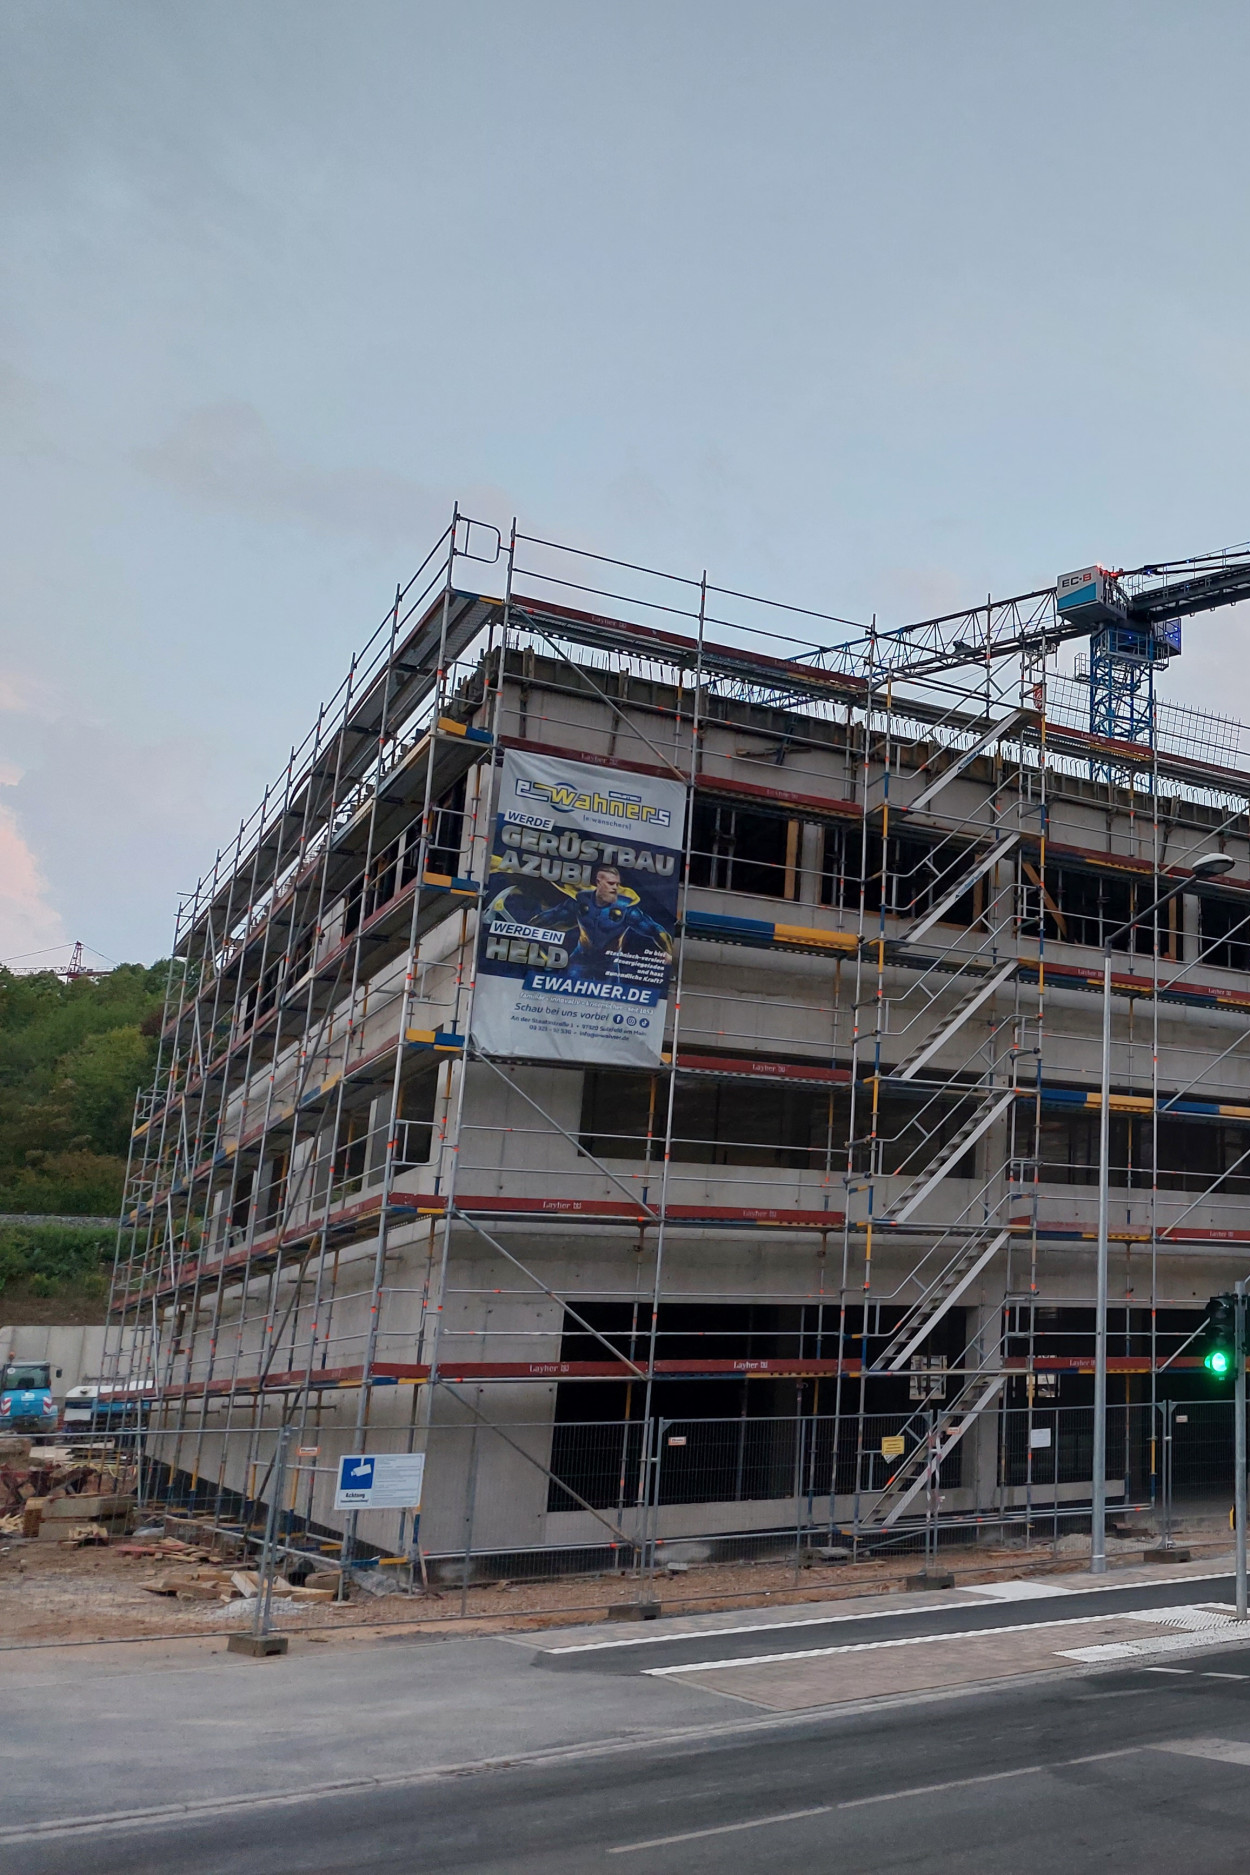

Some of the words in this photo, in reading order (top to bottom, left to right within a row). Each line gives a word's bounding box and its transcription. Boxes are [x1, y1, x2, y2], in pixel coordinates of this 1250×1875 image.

[1062, 573, 1092, 588] EC-B
[508, 810, 552, 829] WERDE
[501, 825, 675, 877] GERÜSTBAU
[500, 850, 593, 886] AZUBI
[494, 922, 540, 938] WERDE
[541, 932, 563, 942] EIN
[485, 936, 569, 969] HELD
[531, 975, 652, 1004] EWAHNER.DE
[513, 1002, 543, 1014] Schau
[545, 1005, 560, 1016] bei
[561, 1009, 578, 1018] uns
[543, 1201, 570, 1210] Layher
[529, 1364, 558, 1374] Layher
[733, 1361, 758, 1370] Layher
